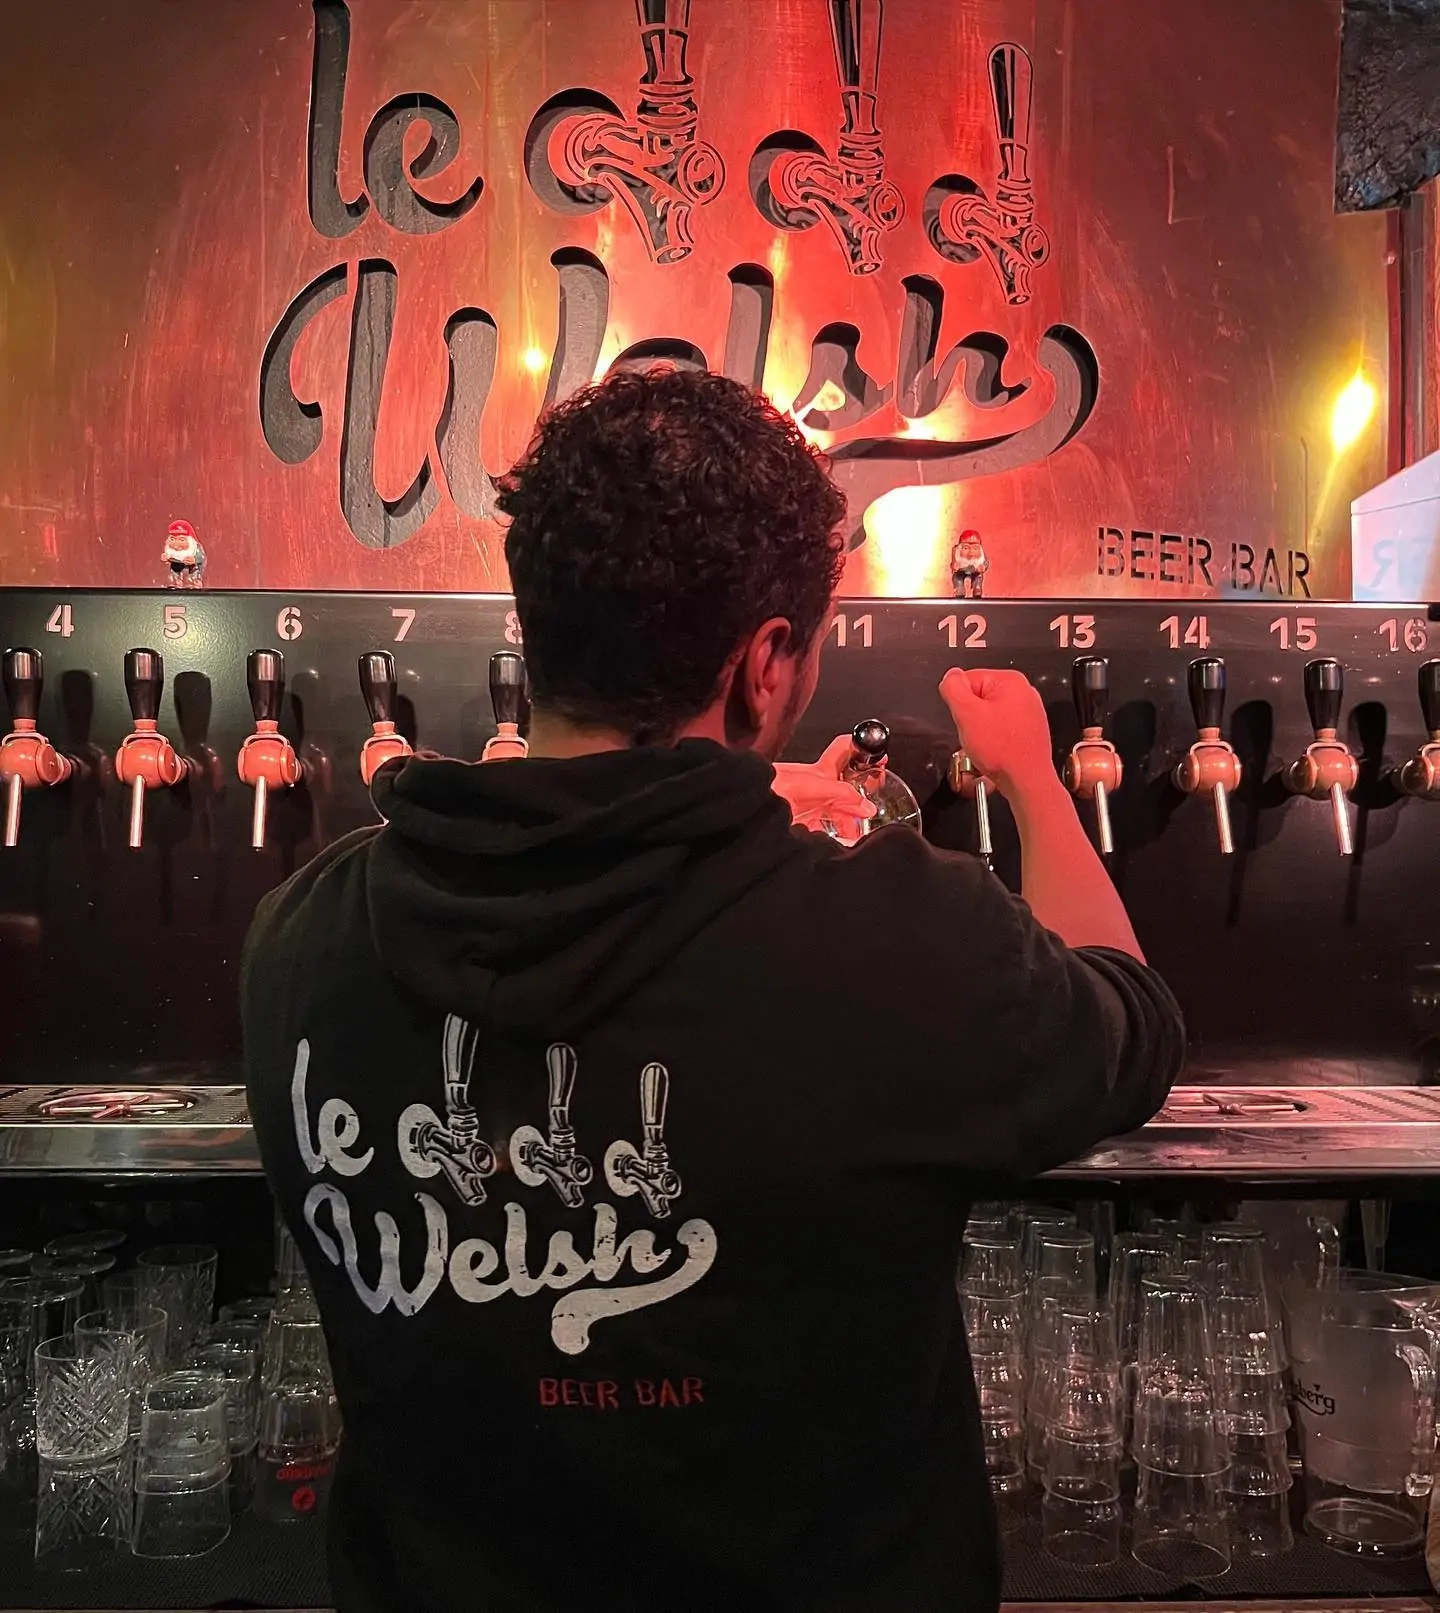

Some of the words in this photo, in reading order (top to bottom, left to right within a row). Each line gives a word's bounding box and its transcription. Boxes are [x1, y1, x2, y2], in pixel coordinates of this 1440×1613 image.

[308, 0, 484, 239] le
[259, 246, 1100, 553] Wlsh
[1097, 526, 1214, 587] BEER
[1231, 542, 1312, 598] BAR
[46, 604, 75, 638] 4
[163, 605, 188, 640] 5
[277, 606, 303, 641] 6
[391, 608, 416, 642] 7
[504, 610, 524, 645] 8
[831, 614, 873, 647] 11
[937, 614, 987, 648] 12
[1049, 615, 1096, 649] 13
[1158, 615, 1210, 649] 14
[1269, 616, 1317, 651] 15
[1379, 618, 1428, 652] 16
[292, 1038, 374, 1176] le
[304, 1183, 717, 1355] Welsh
[539, 1377, 619, 1409] BEER
[635, 1377, 704, 1407] BAR
